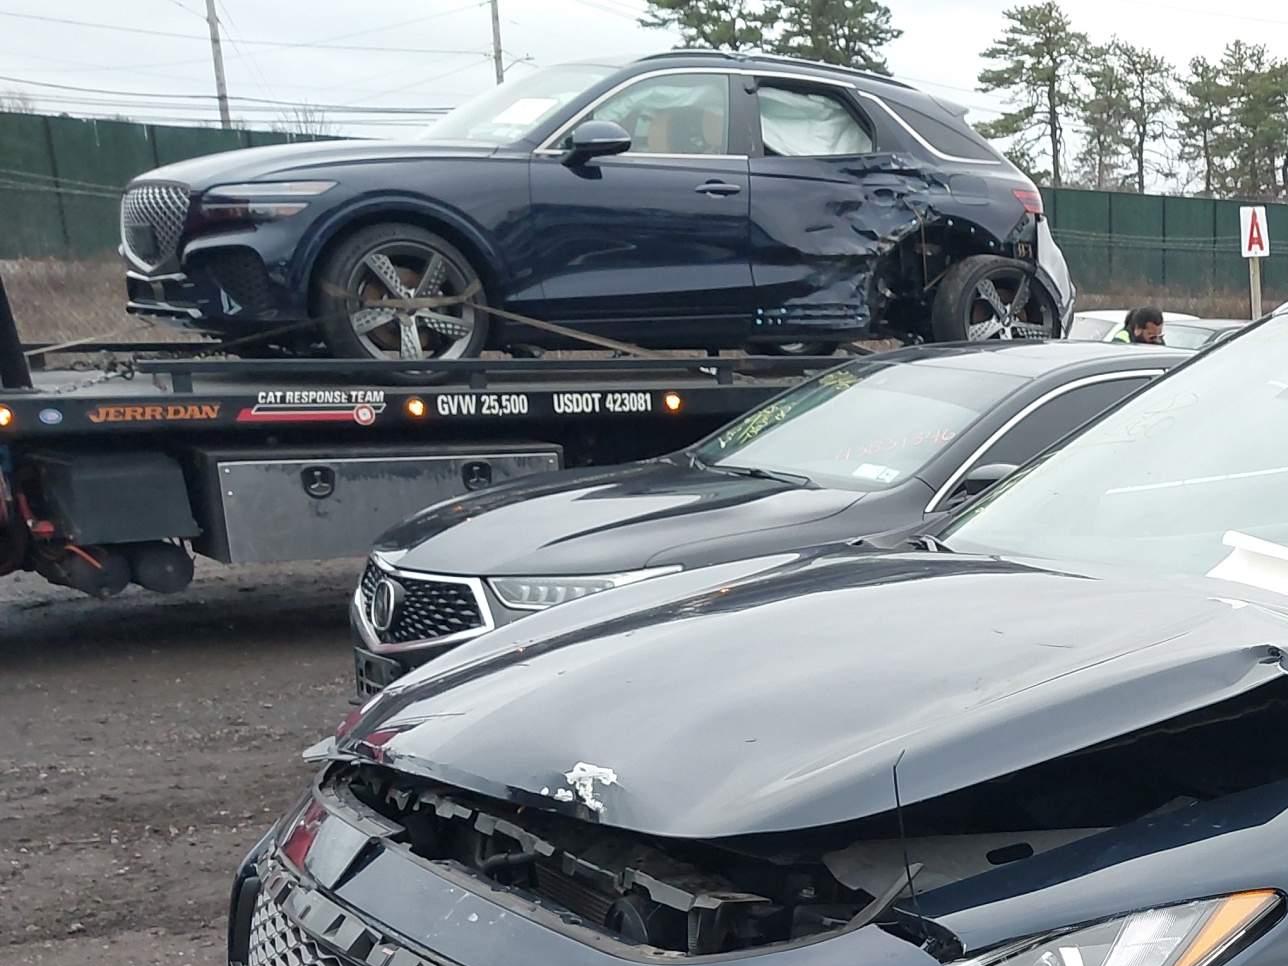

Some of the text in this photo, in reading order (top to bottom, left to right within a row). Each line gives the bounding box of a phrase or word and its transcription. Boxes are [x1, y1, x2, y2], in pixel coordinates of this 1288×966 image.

[1247, 207, 1264, 251] A
[258, 391, 384, 403] CAT RESPONSE TEAM
[437, 395, 528, 416] GVW 25,500
[553, 393, 652, 413] USDOT 423081
